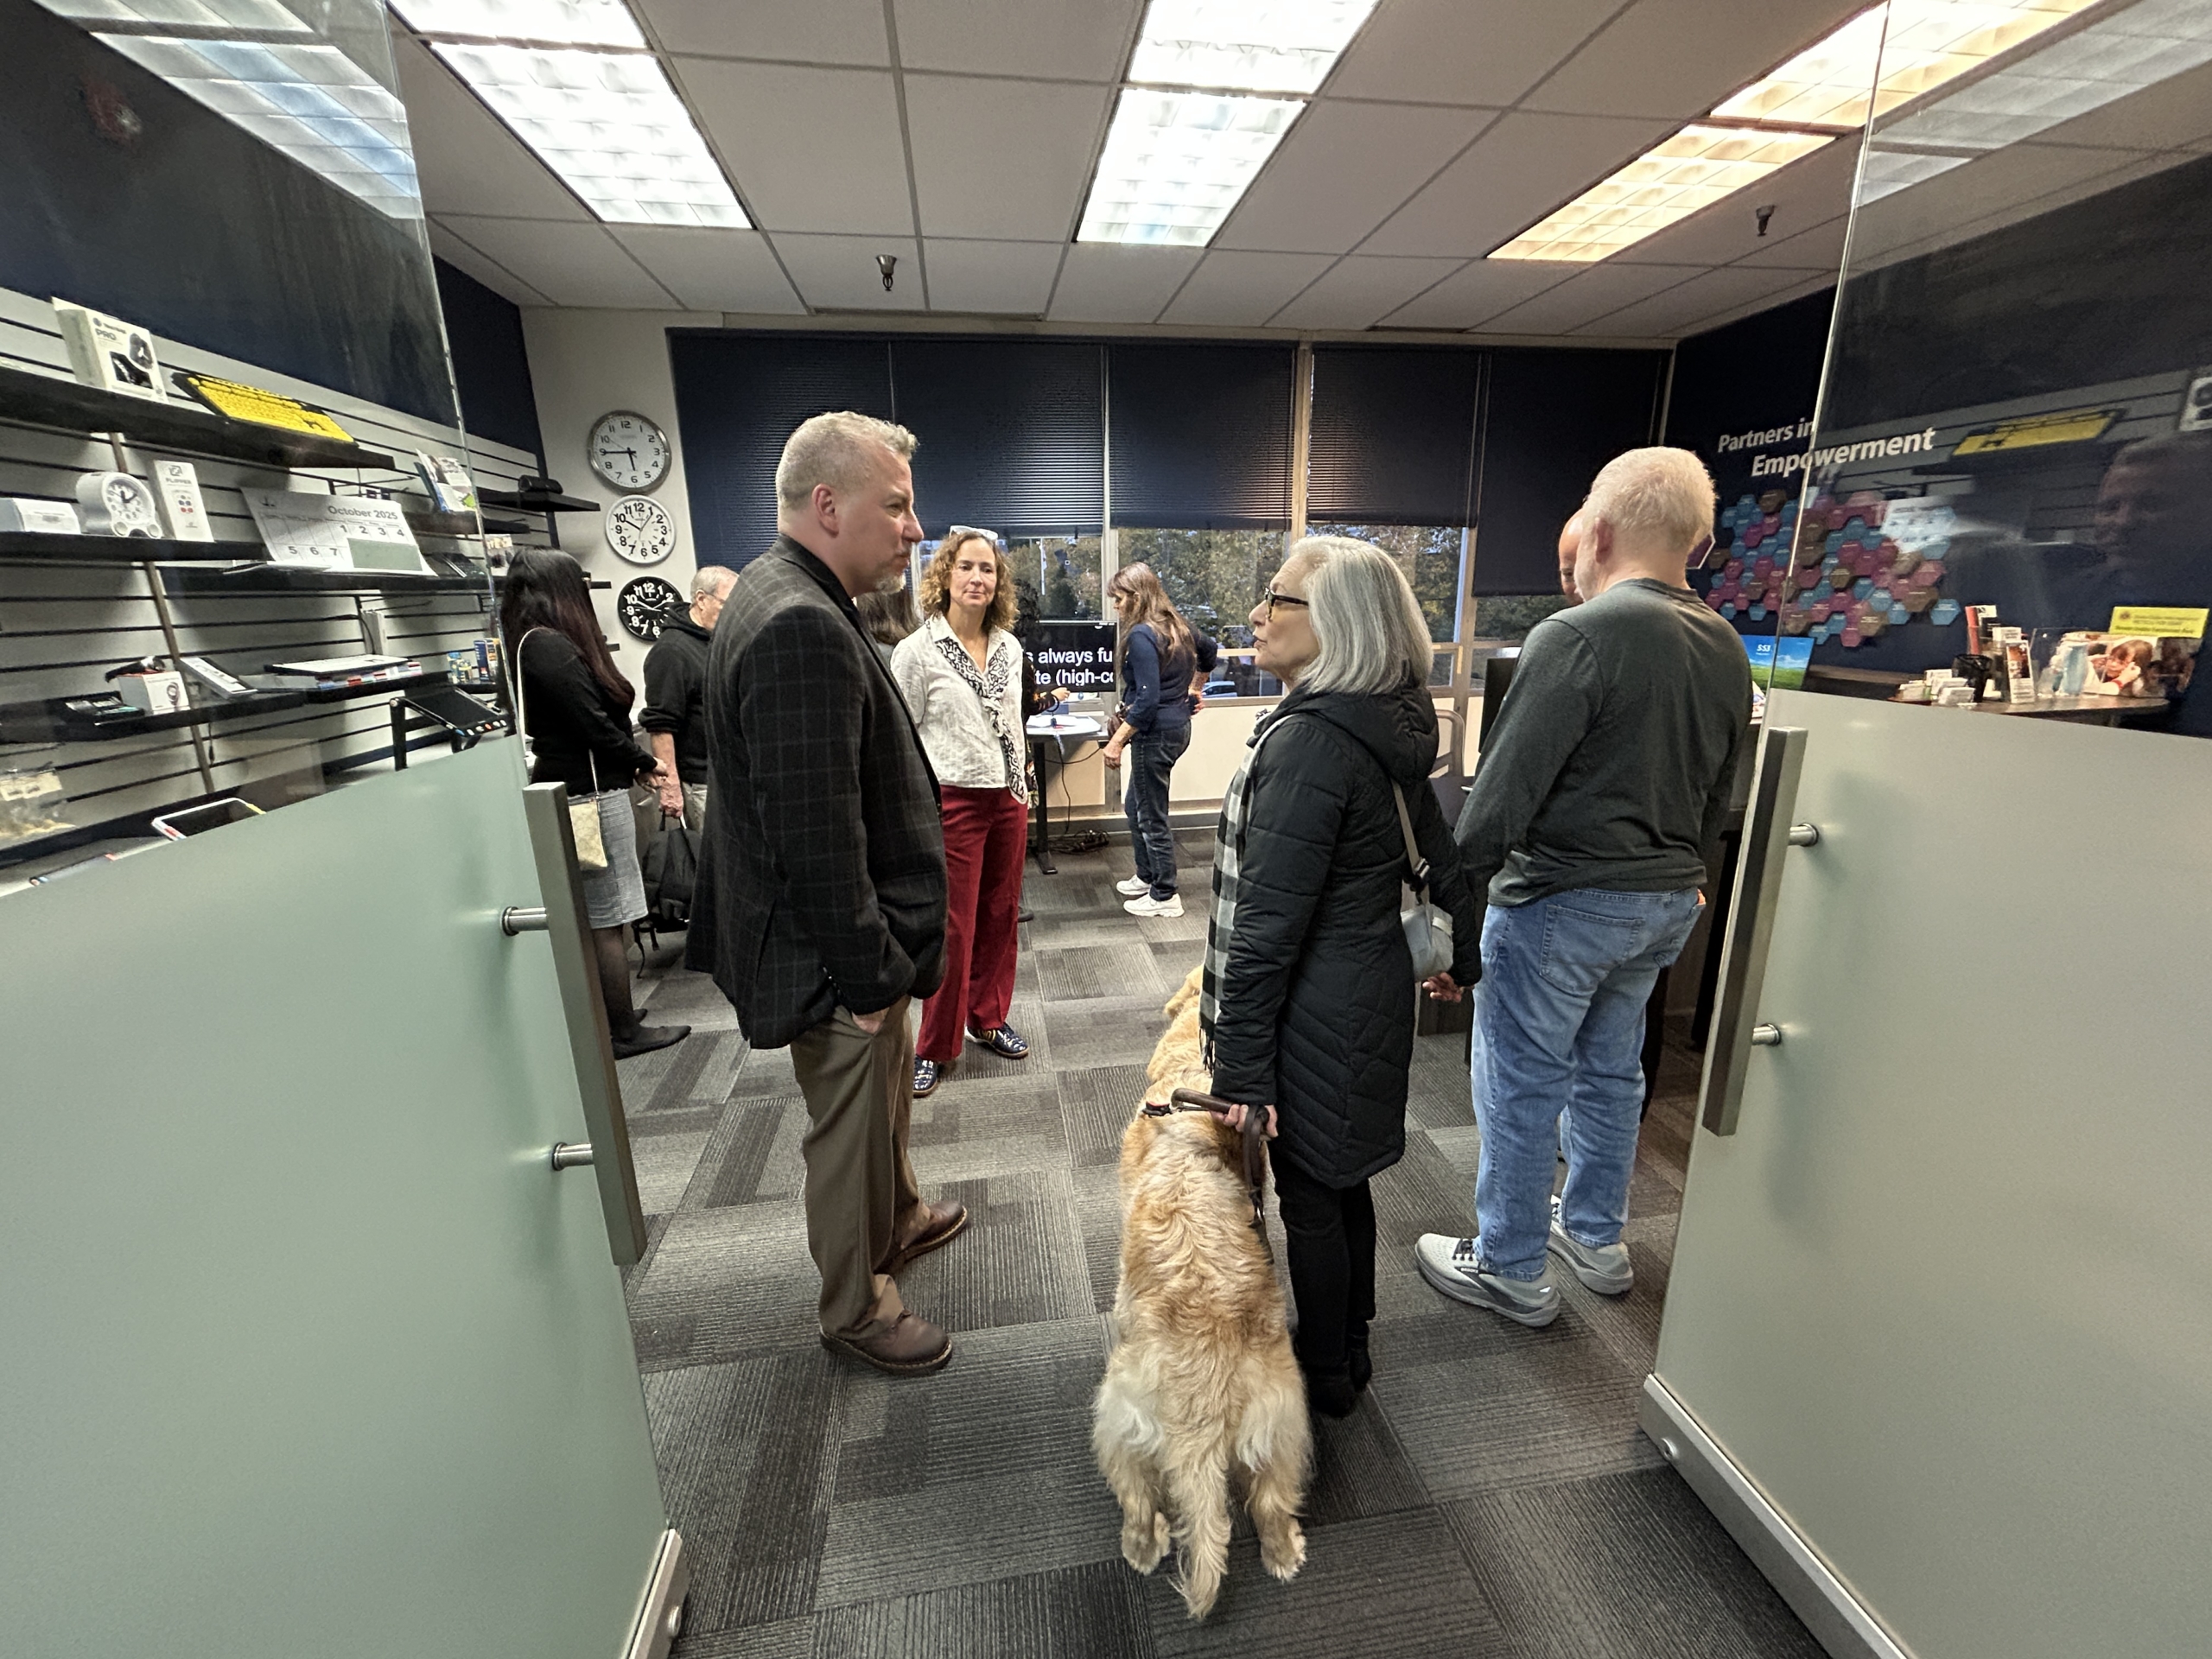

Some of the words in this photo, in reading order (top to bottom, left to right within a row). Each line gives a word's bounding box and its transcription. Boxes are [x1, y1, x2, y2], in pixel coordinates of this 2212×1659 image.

[95, 327, 117, 340] PRO
[1718, 423, 1793, 453] Partners
[1751, 426, 1936, 478] Empowerment
[327, 505, 372, 518] October
[375, 510, 398, 520] 2025
[624, 505, 632, 514] 11
[633, 503, 645, 512] 12
[648, 506, 653, 515] 1
[614, 513, 626, 523] 10
[656, 514, 664, 524] 2
[340, 524, 347, 533] 1
[359, 525, 369, 535] 2
[378, 527, 386, 536] 3
[397, 529, 405, 537] 4
[615, 524, 622, 534] 9
[661, 525, 667, 535] 3
[620, 536, 627, 546] 8
[658, 537, 666, 546] 4
[289, 546, 298, 555] 5
[309, 547, 319, 556] 6
[329, 548, 338, 556] 7
[628, 545, 636, 554] 7
[640, 548, 648, 556] 6
[652, 545, 658, 554] 5
[634, 586, 642, 595] 11
[643, 582, 655, 593] 12
[658, 585, 664, 595] 1
[626, 594, 638, 604] 10
[665, 593, 674, 602] 2
[626, 606, 634, 615] 9
[631, 616, 639, 627] 8
[640, 624, 648, 633] 7
[652, 626, 660, 636] 6
[1038, 648, 1093, 666] always
[1096, 647, 1113, 663] fu
